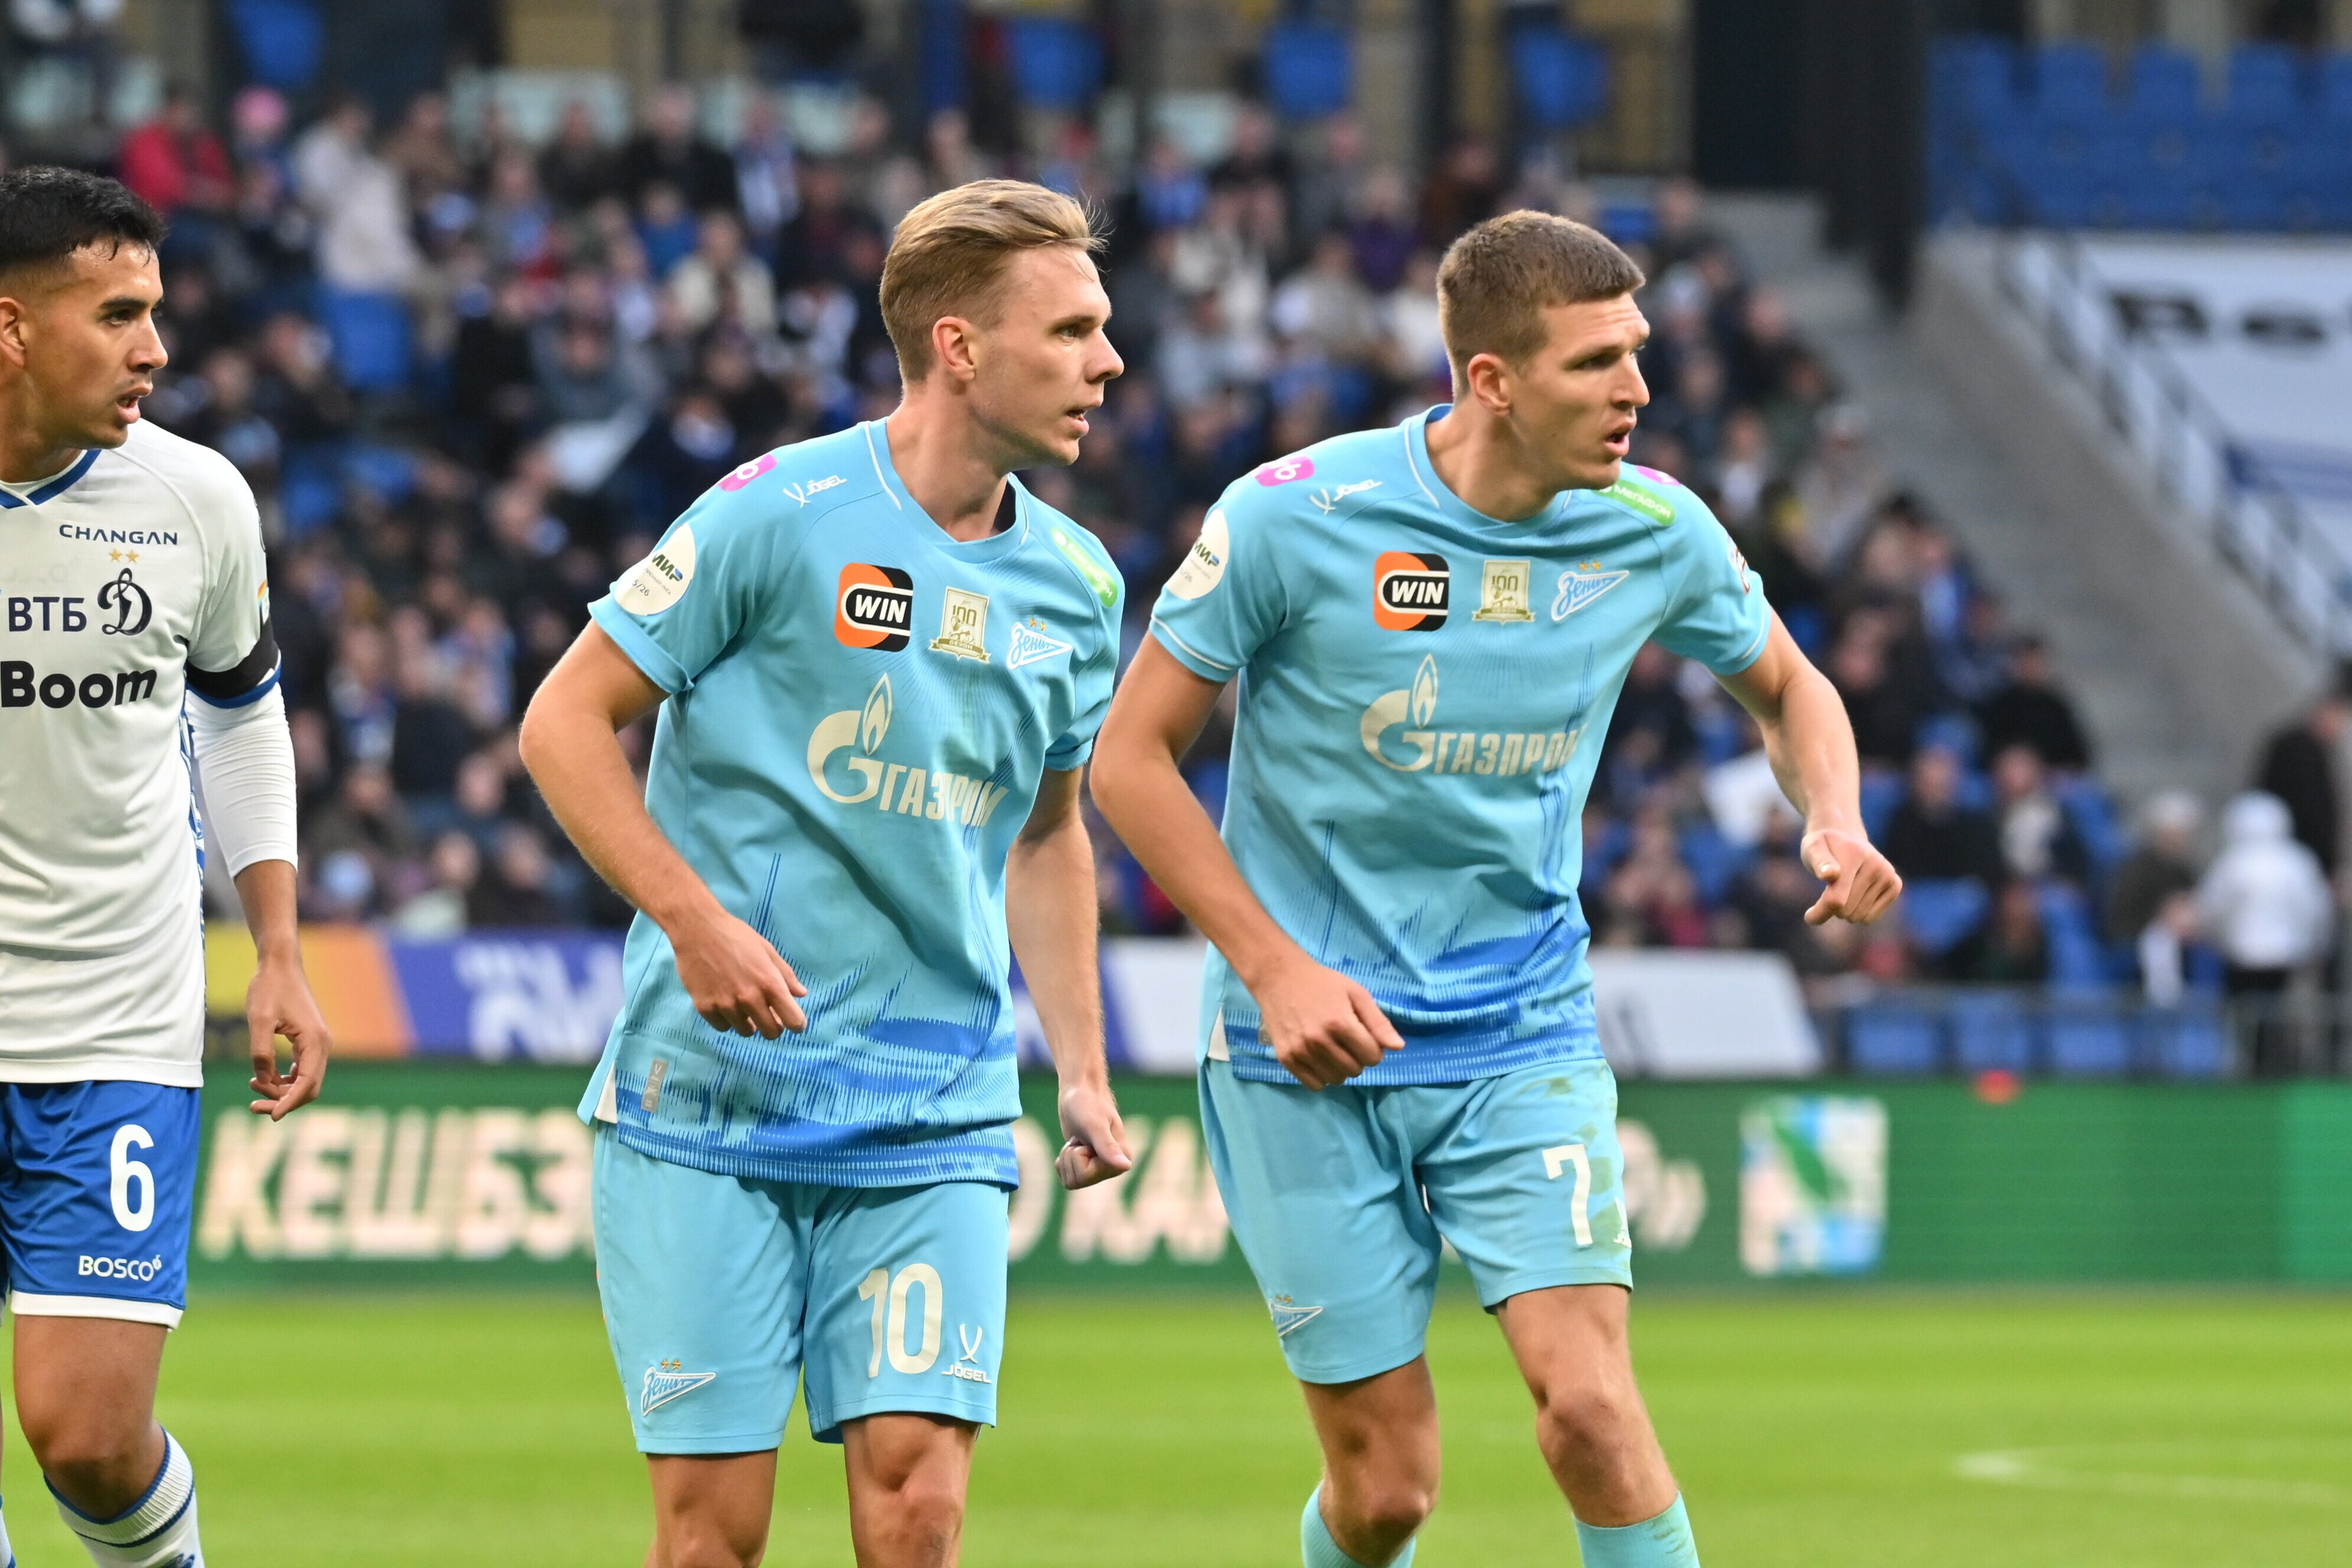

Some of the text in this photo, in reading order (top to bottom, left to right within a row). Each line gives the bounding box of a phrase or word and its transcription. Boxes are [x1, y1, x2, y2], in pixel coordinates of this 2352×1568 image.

[59, 524, 178, 545] CHANGAN
[854, 594, 907, 623] WIN
[1391, 580, 1445, 605] WIN
[8, 596, 87, 632] ВТБ
[0, 661, 158, 708] Boom
[110, 1124, 155, 1232] 6
[197, 1105, 596, 1260] КЕШБЭ
[1542, 1144, 1592, 1246] 7
[78, 1255, 155, 1282] BOSCO
[858, 1263, 943, 1378] 10
